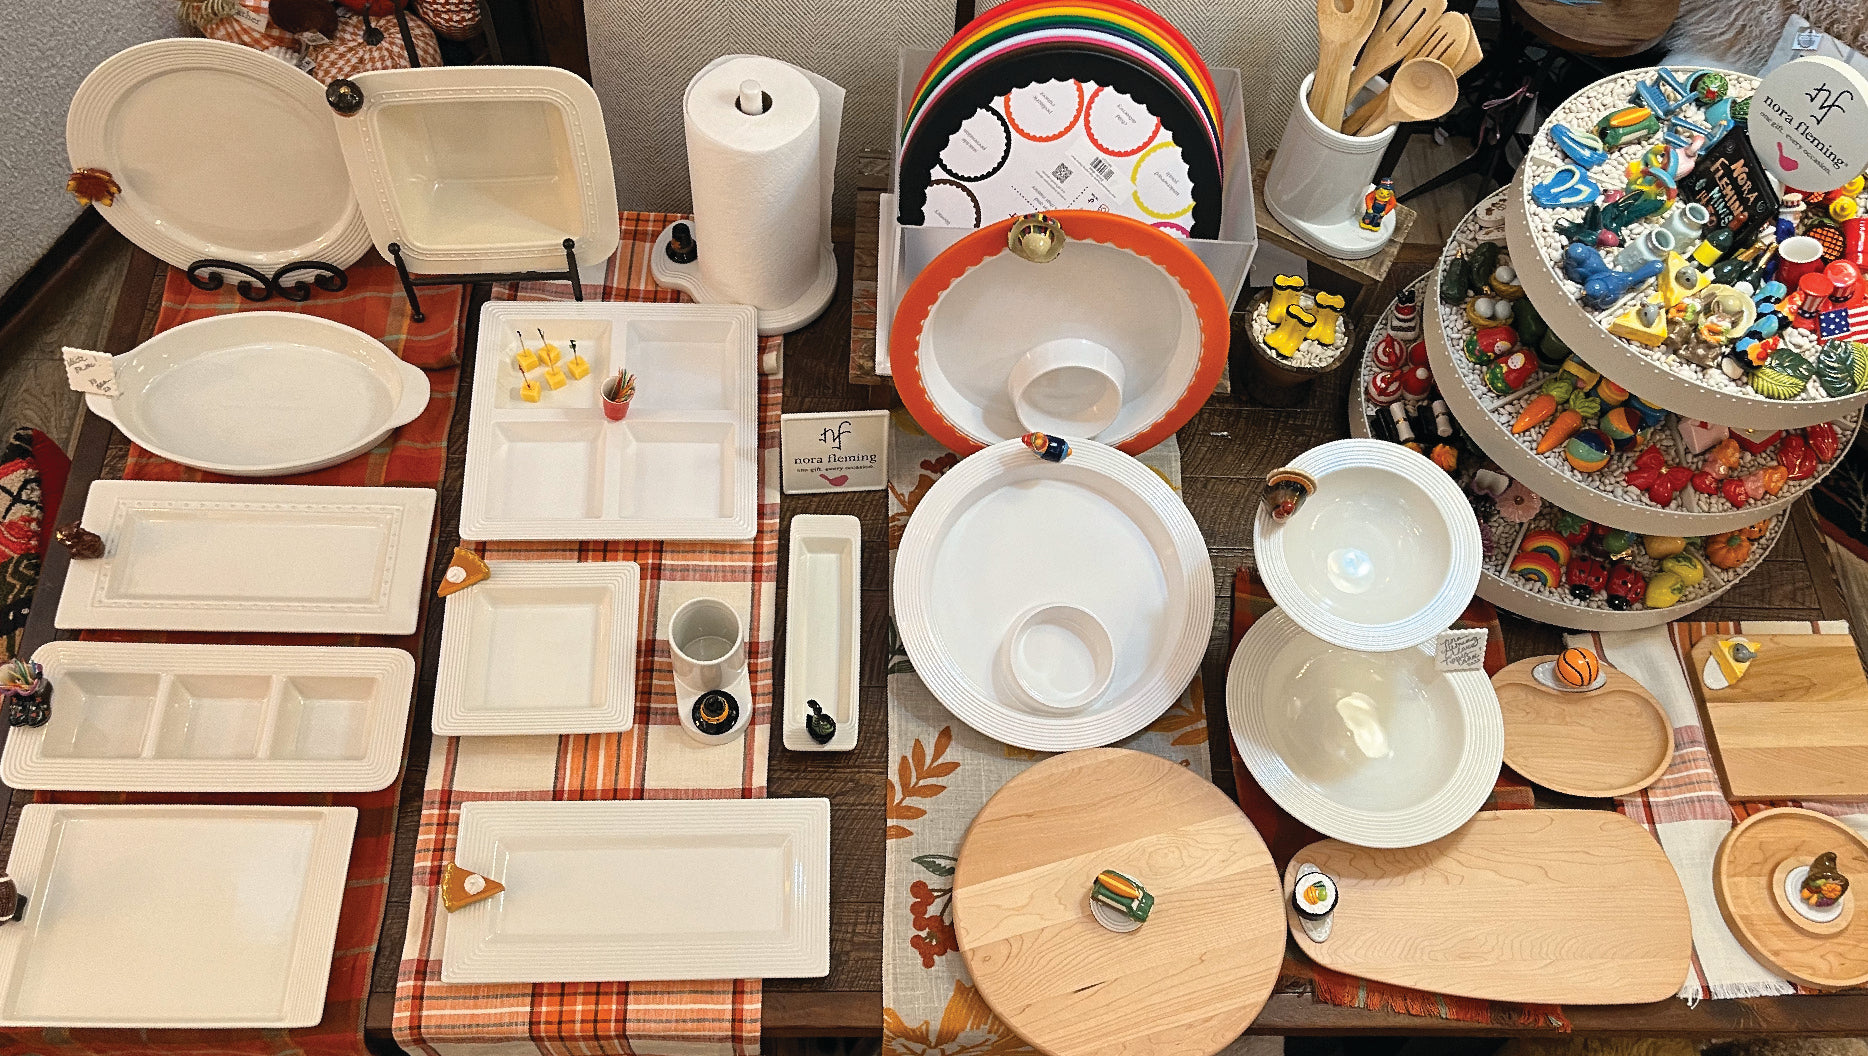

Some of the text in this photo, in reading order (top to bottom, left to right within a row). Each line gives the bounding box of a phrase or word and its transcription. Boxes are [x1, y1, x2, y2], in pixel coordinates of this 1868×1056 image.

[236, 10, 260, 25] ather
[1760, 111, 1771, 123] one
[1770, 120, 1785, 135] gift.
[1785, 133, 1802, 150] every
[1763, 95, 1845, 170] nora fleming
[1710, 157, 1749, 219] FLEMIN
[1730, 158, 1759, 206] NORA
[1709, 186, 1734, 227] MINIS
[818, 420, 852, 451] nf
[794, 453, 877, 465] nora fleming
